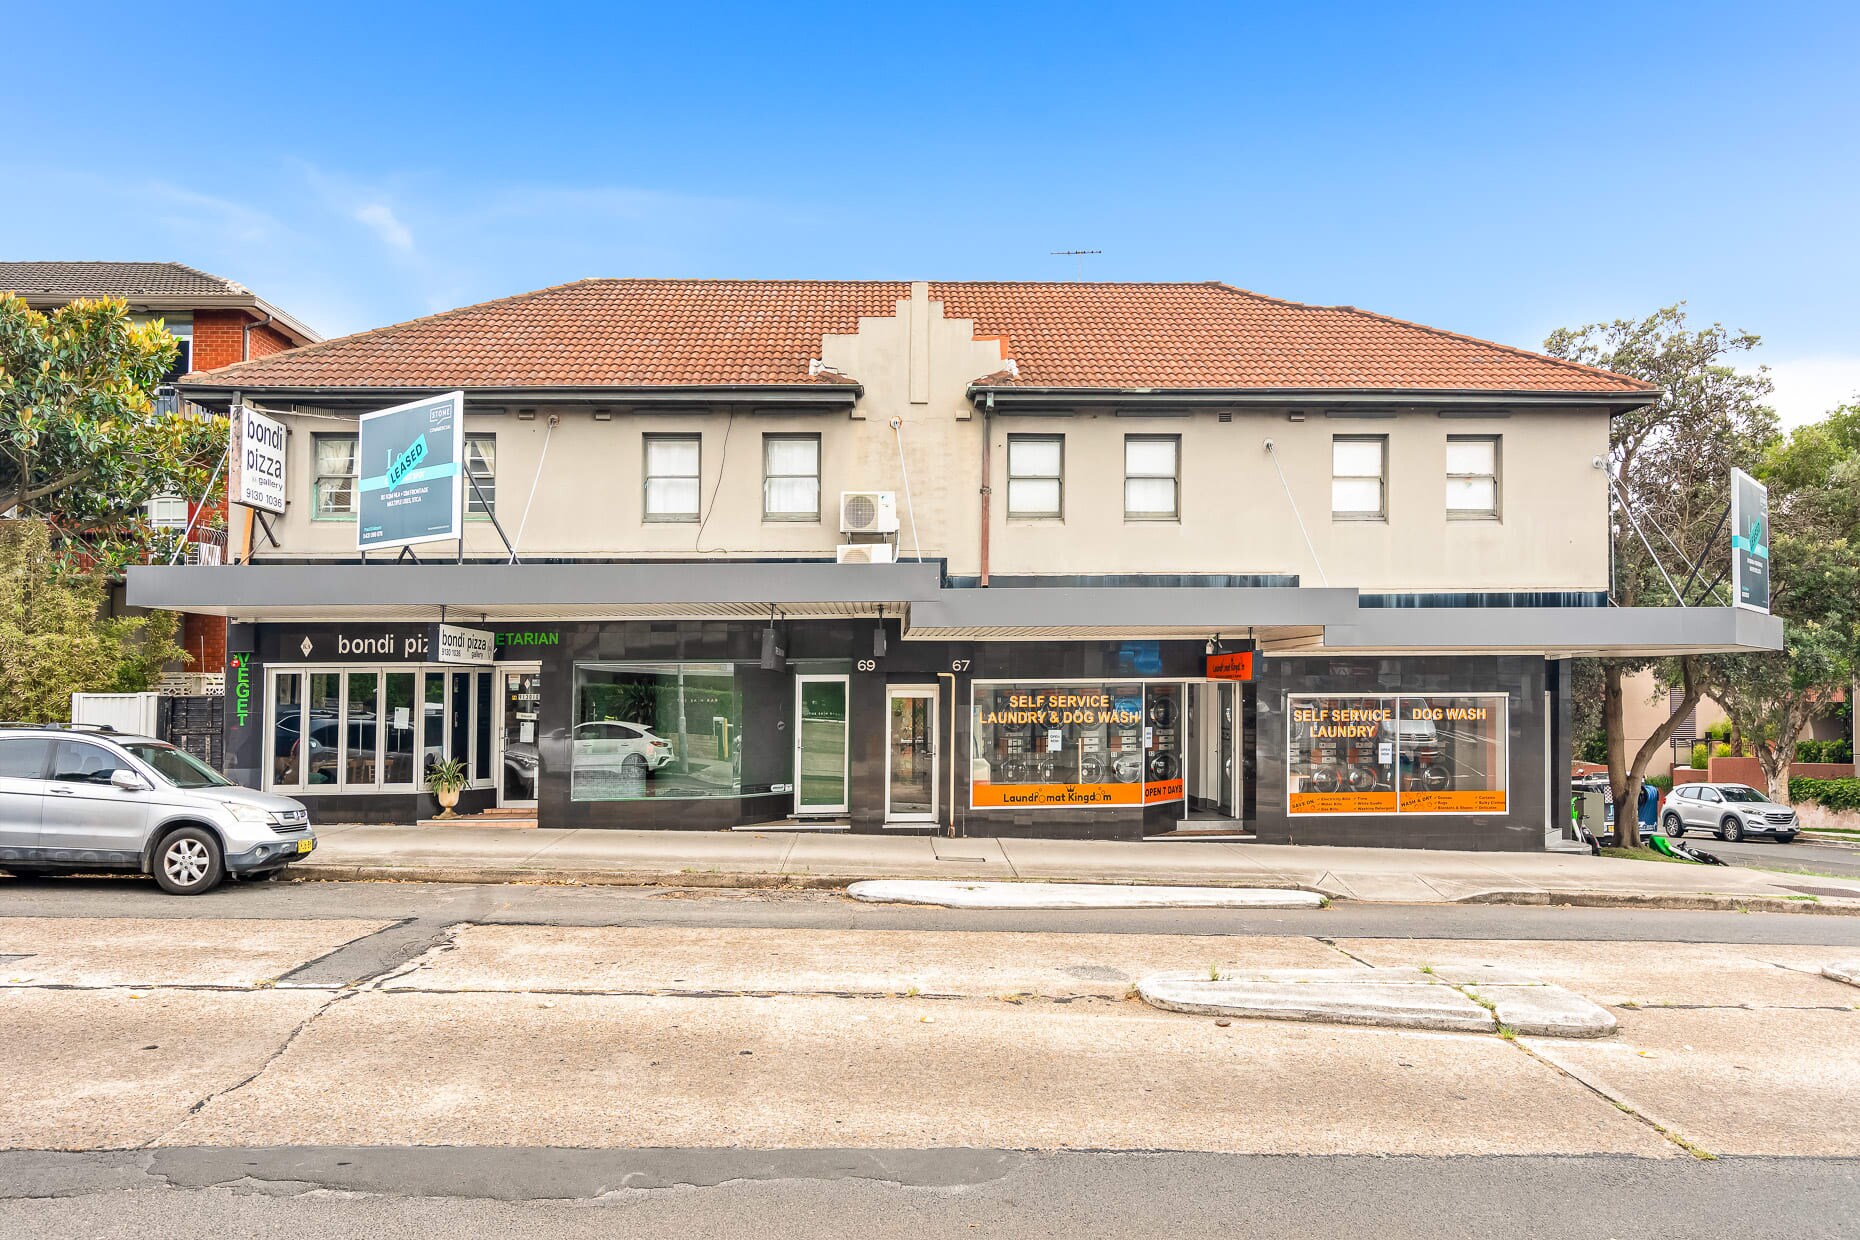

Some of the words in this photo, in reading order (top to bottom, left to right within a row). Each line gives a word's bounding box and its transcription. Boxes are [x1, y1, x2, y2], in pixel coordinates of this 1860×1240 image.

[248, 413, 283, 451] bondi
[247, 448, 282, 480] pizza
[390, 443, 423, 484] LEASED
[258, 477, 283, 492] gallery
[246, 488, 264, 502] 9130
[265, 494, 283, 508] 1036
[338, 634, 394, 654] bondi
[404, 633, 429, 658] piz
[442, 630, 465, 648] bondi
[467, 634, 487, 652] pizza
[495, 632, 559, 646] ETARIAN
[857, 659, 876, 672] 69
[952, 659, 971, 672] 67
[236, 652, 250, 727] VEGET
[1009, 695, 1045, 708] SELF
[1048, 695, 1110, 708] SERVICE
[979, 711, 1047, 724] LAUNDRY
[1049, 711, 1060, 724] &
[1063, 711, 1095, 724] DOG
[1097, 711, 1140, 724] WASH
[1293, 709, 1328, 722] SELF
[1331, 709, 1392, 722] SERVICE
[1412, 708, 1444, 721] DOG
[1446, 708, 1487, 720] WASH
[1310, 725, 1376, 738] LAUNDRY
[1145, 786, 1162, 797] OPEN
[1162, 786, 1167, 796] 7
[1167, 784, 1183, 795] DAYS
[1401, 799, 1416, 807] WASH
